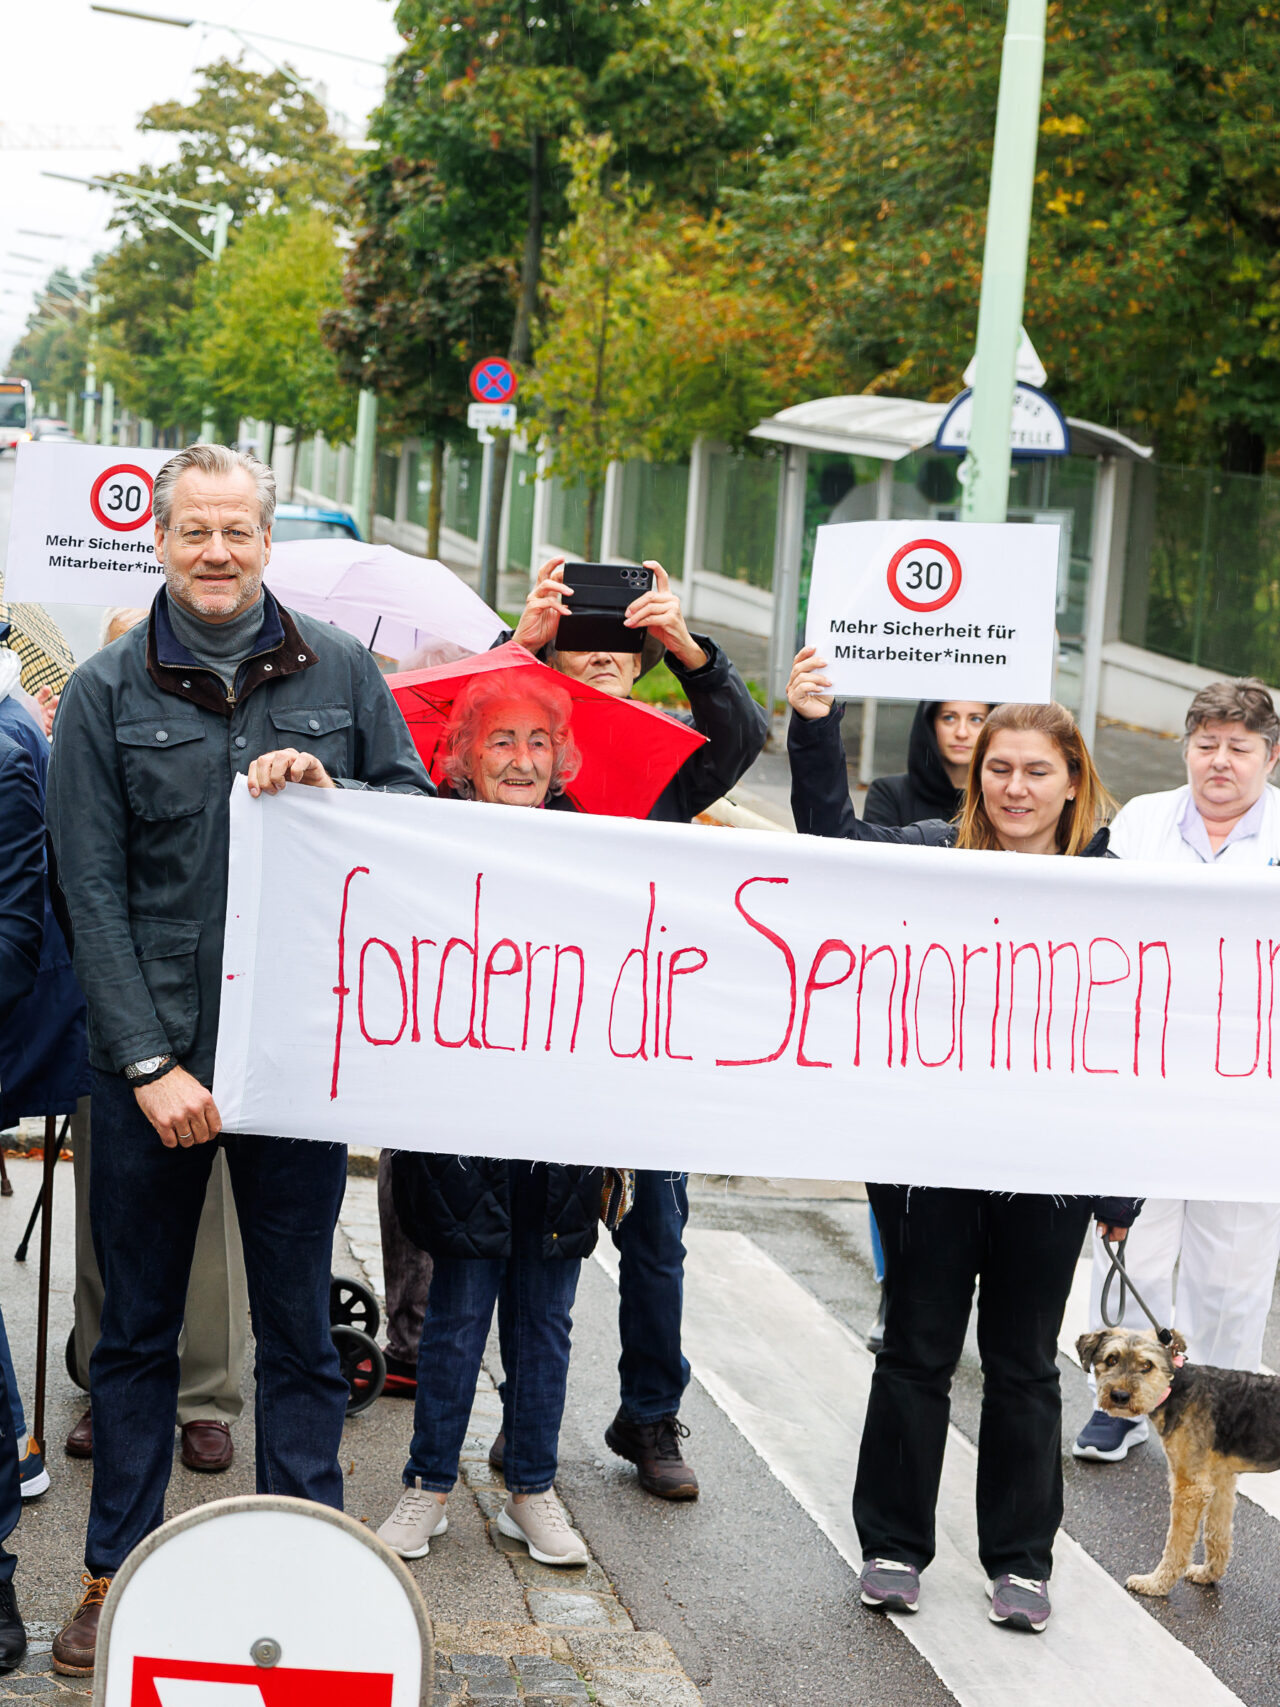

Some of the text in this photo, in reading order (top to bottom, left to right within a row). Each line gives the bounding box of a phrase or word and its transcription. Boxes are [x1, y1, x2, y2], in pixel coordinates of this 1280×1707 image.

[107, 484, 142, 512] 30
[45, 534, 155, 555] Mehr Sicherhe
[48, 555, 165, 575] Mitarbeiterinn
[906, 560, 943, 591] 30
[829, 619, 1017, 639] Mehr Sicherheit für
[330, 865, 585, 1101] fordern
[608, 881, 709, 1061] die
[715, 876, 1172, 1079] Seniorinnen
